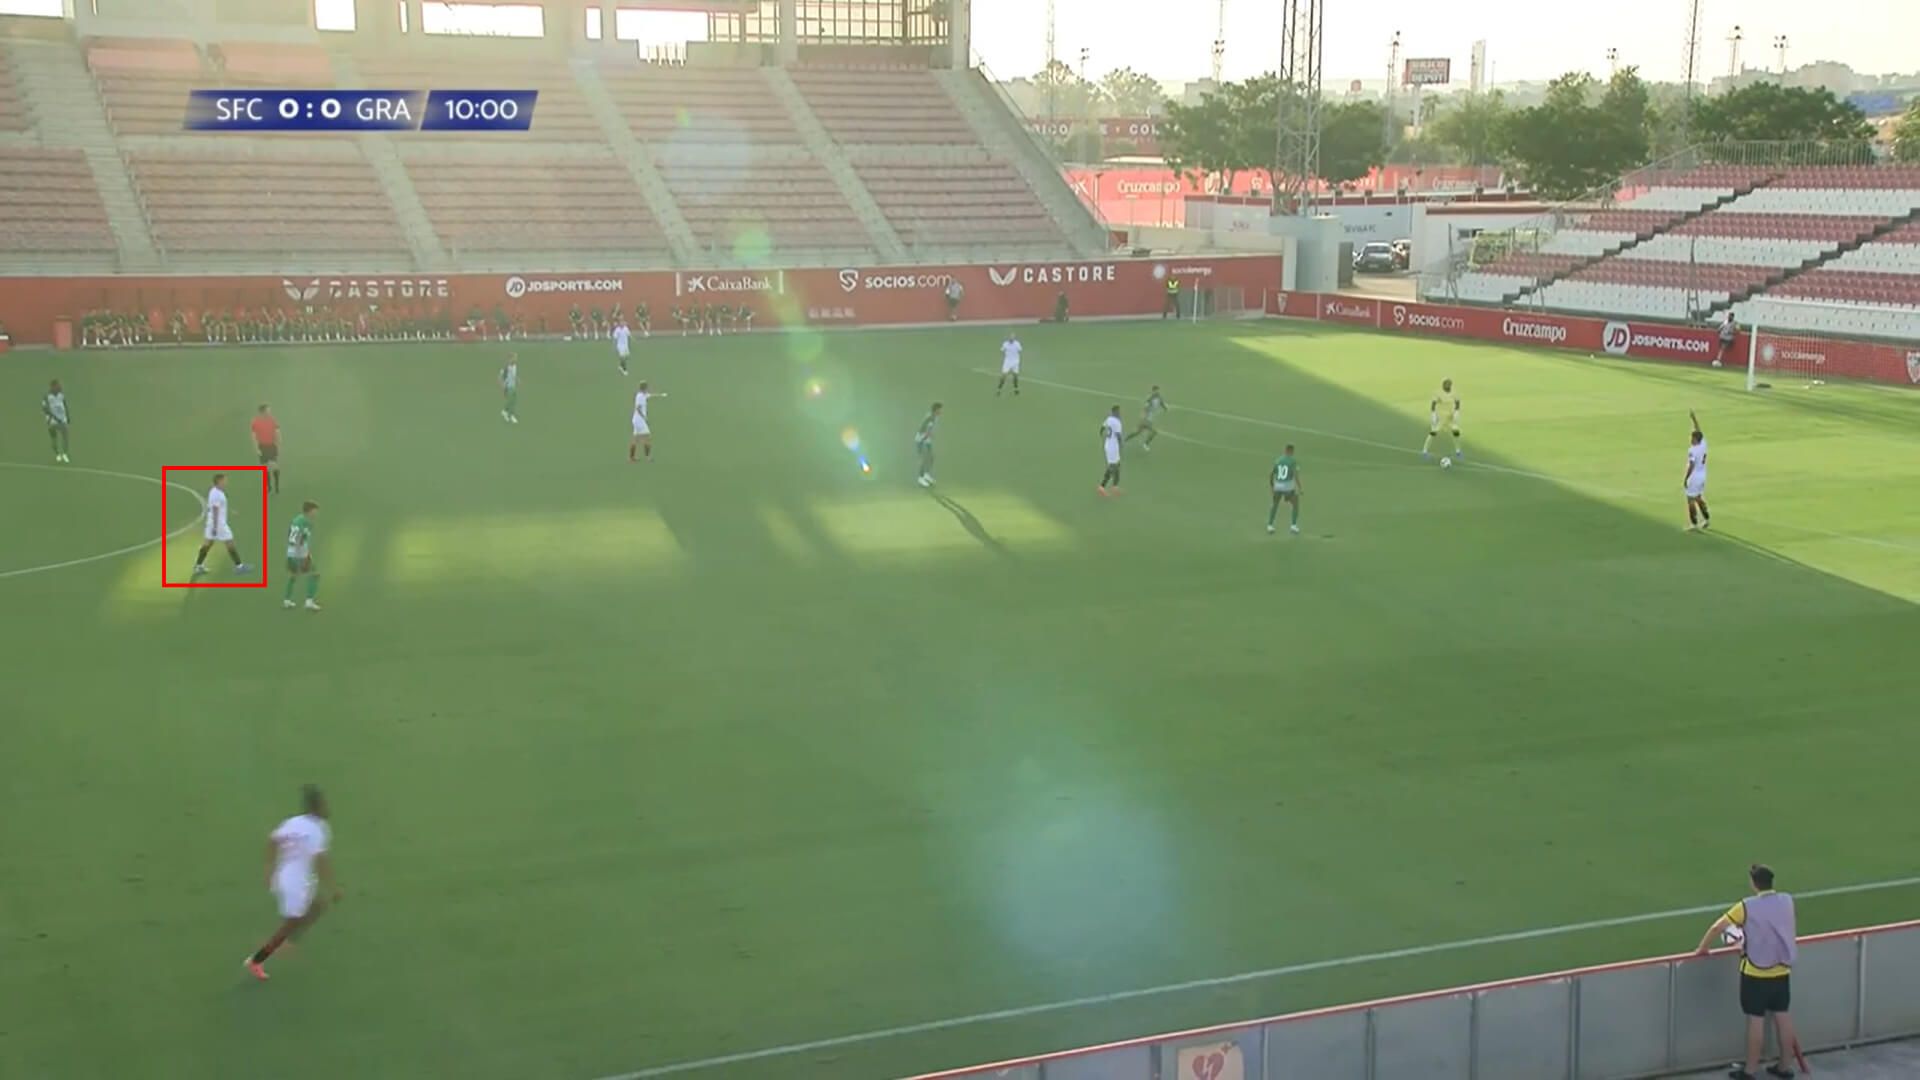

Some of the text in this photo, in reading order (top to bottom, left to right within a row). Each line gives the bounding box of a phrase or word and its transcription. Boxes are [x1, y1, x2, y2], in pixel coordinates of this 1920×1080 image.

[1117, 179, 1181, 195] Cruzcampo
[1023, 265, 1116, 283] CASTORE
[527, 280, 623, 292] JDSPORTS.COM
[706, 276, 772, 291] CaixaBank
[1503, 317, 1567, 342] Cruzcampo
[1631, 333, 1710, 353] JDSPORTS.COM
[1277, 464, 1289, 480] 10
